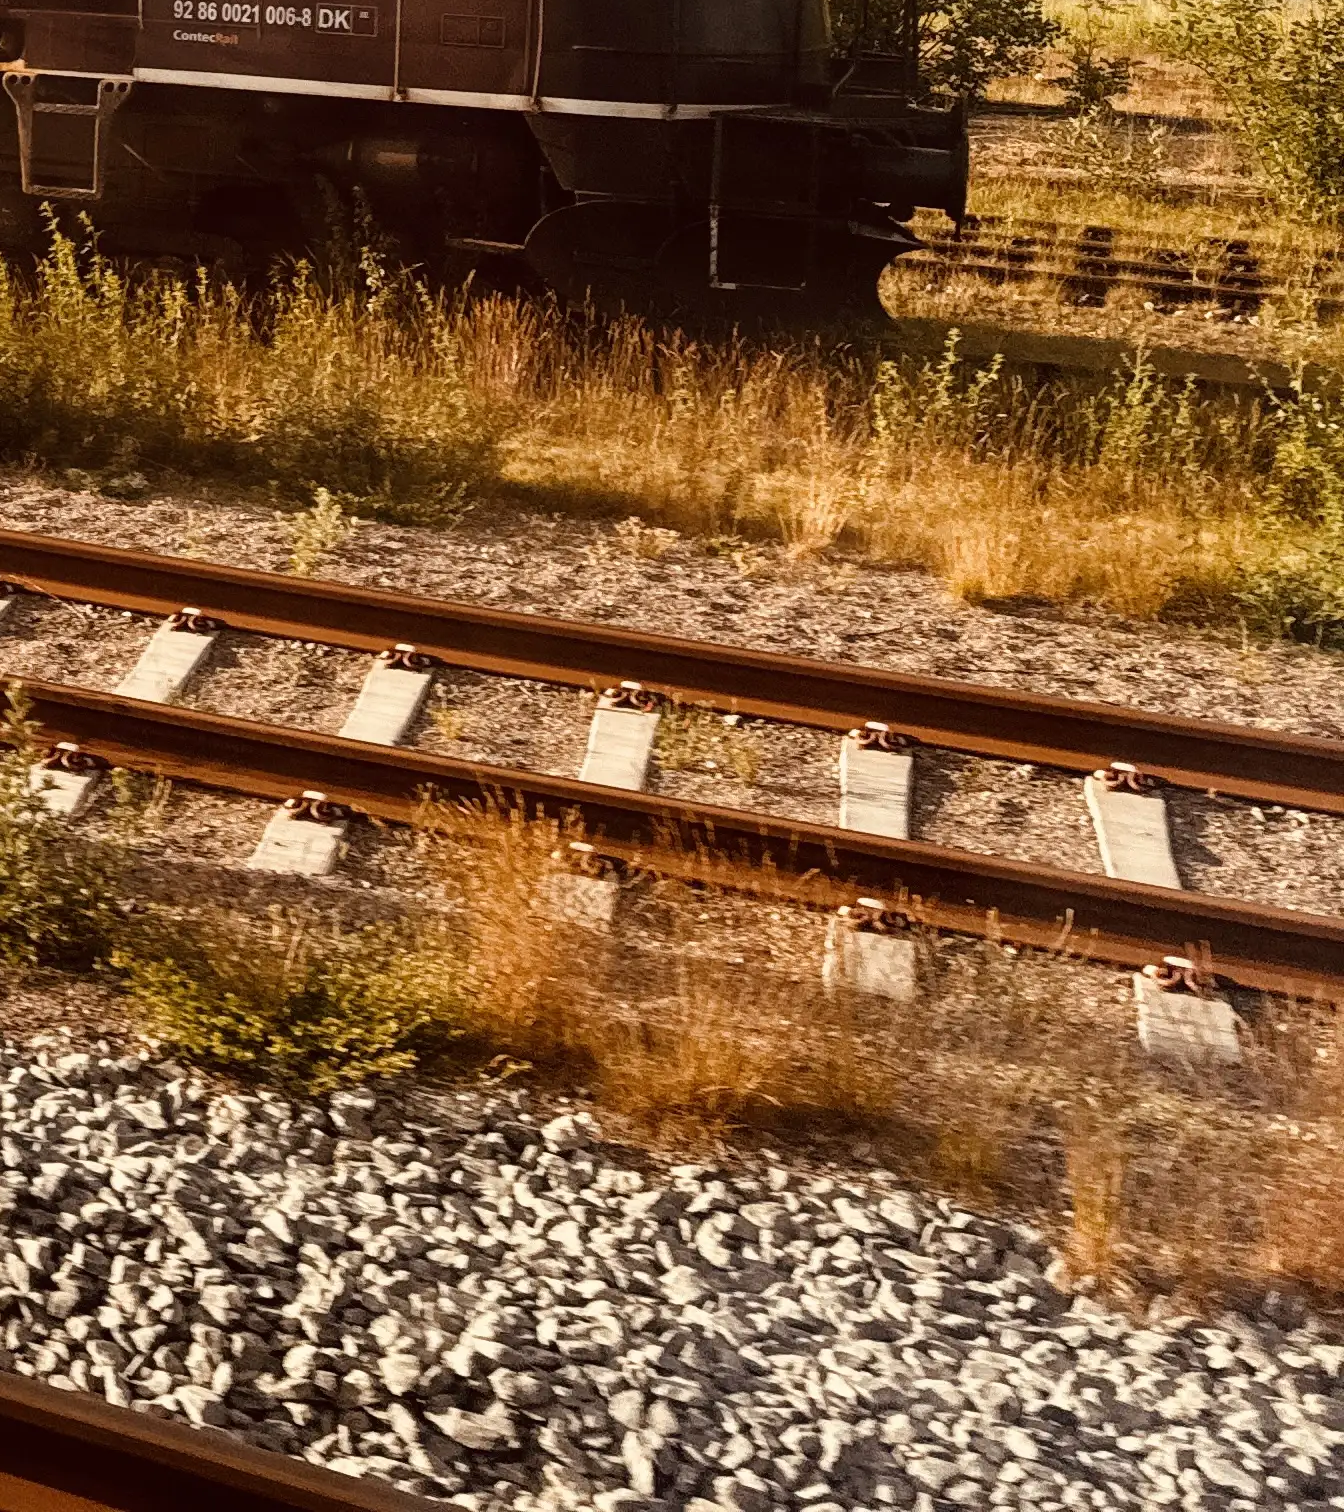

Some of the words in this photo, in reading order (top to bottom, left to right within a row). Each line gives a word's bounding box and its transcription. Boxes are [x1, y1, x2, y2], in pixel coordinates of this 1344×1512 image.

[173, 0, 193, 19] 92
[197, 1, 217, 21] 86
[221, 3, 260, 24] 0021
[265, 5, 312, 27] 006-8
[318, 8, 351, 30] DK
